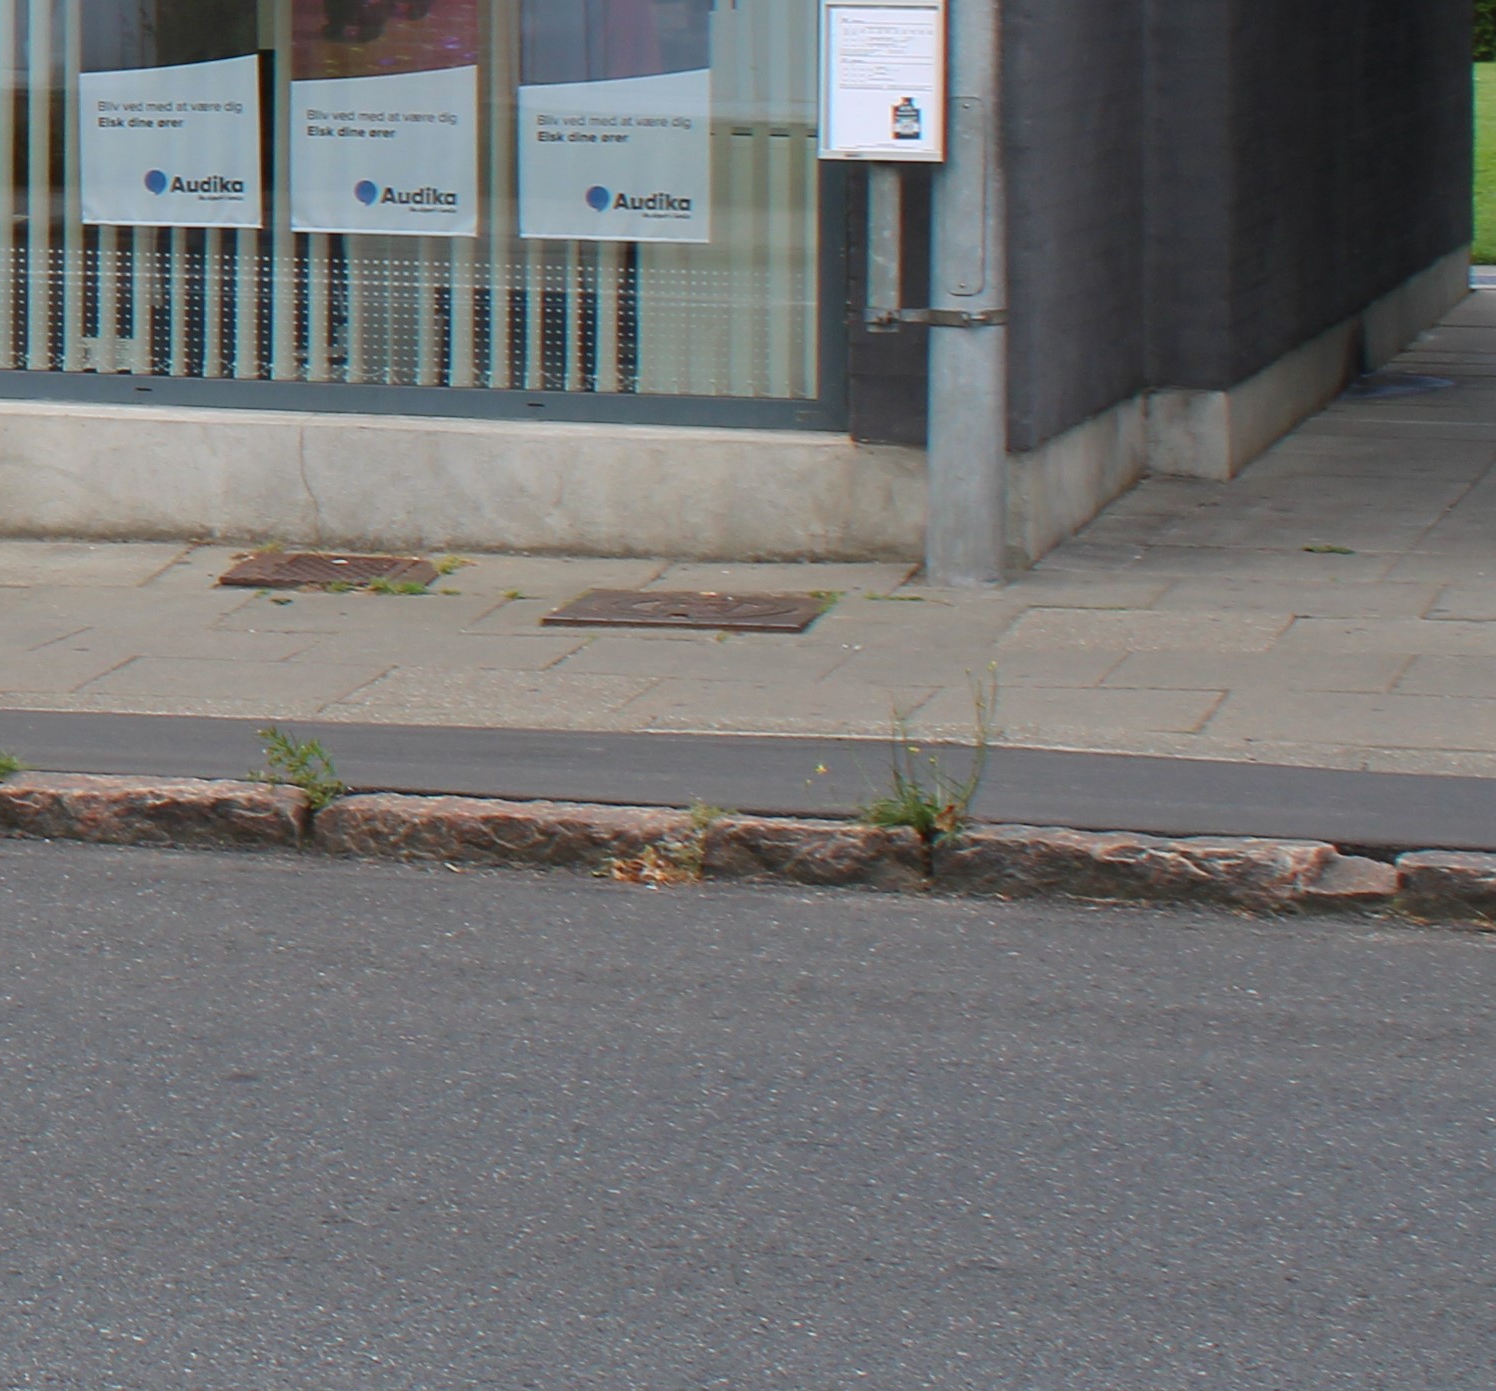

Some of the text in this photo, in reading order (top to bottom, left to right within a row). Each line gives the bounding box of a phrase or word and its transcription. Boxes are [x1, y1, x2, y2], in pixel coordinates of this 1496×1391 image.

[170, 175, 244, 192] Audika
[381, 187, 457, 205] Audika
[614, 193, 691, 211] Audika
